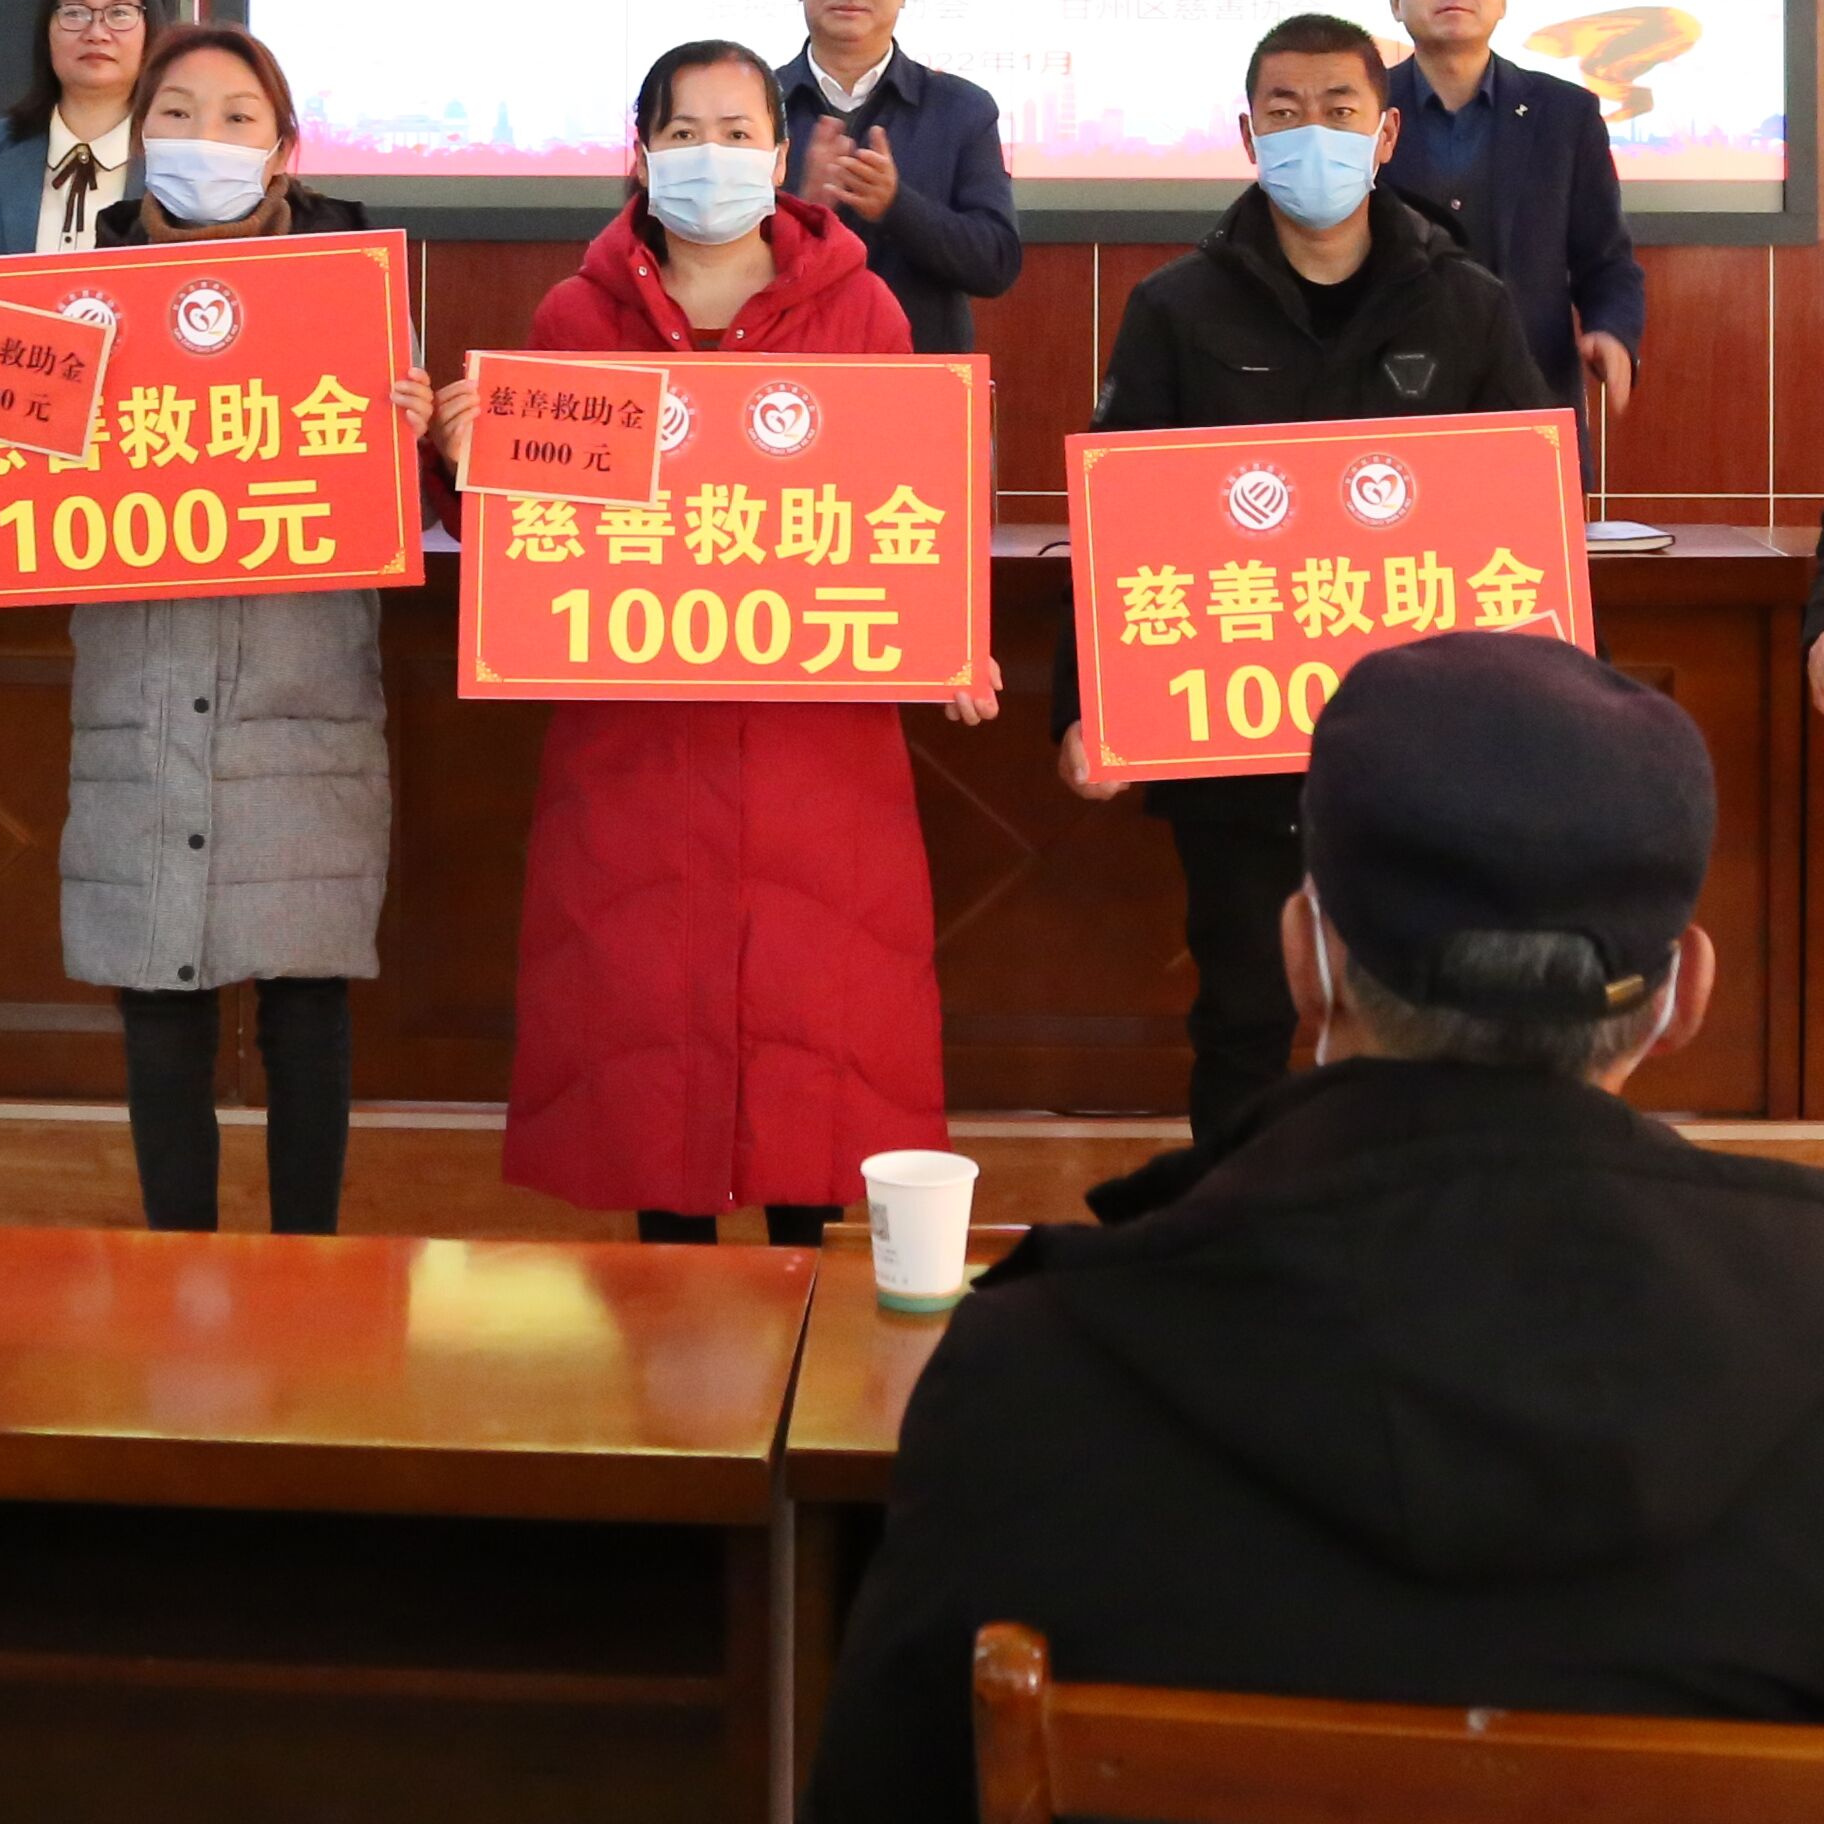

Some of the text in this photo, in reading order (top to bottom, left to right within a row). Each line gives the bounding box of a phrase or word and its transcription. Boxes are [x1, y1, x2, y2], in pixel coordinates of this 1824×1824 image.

[24, 393, 53, 423] 元
[486, 386, 646, 430] 慈善救助金
[510, 438, 612, 473] 1000 元
[505, 482, 947, 566] 慈善救助金
[1116, 546, 1545, 647] 慈善救助金
[550, 587, 903, 675] 1000元
